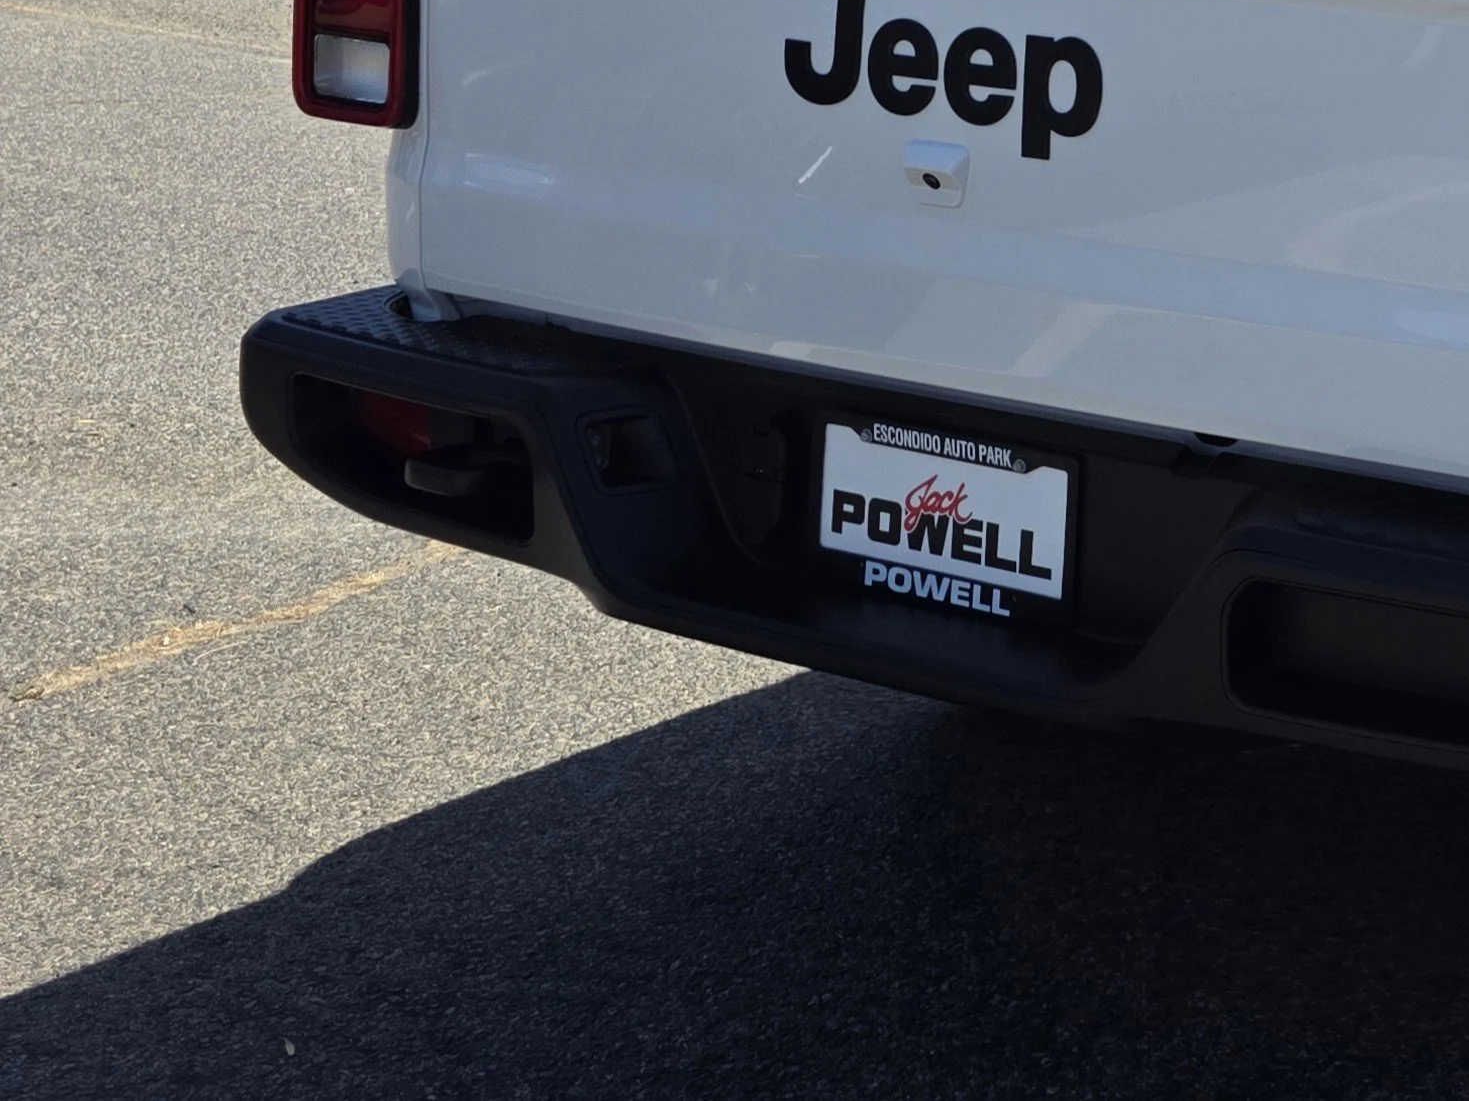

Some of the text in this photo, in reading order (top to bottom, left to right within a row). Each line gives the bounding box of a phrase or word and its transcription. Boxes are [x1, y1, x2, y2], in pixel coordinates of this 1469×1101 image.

[873, 423, 1012, 468] ESCONDIDO AUTO PARK
[904, 474, 973, 533] Jack
[831, 489, 1052, 581] POWELL
[864, 560, 1010, 617] POWELL
